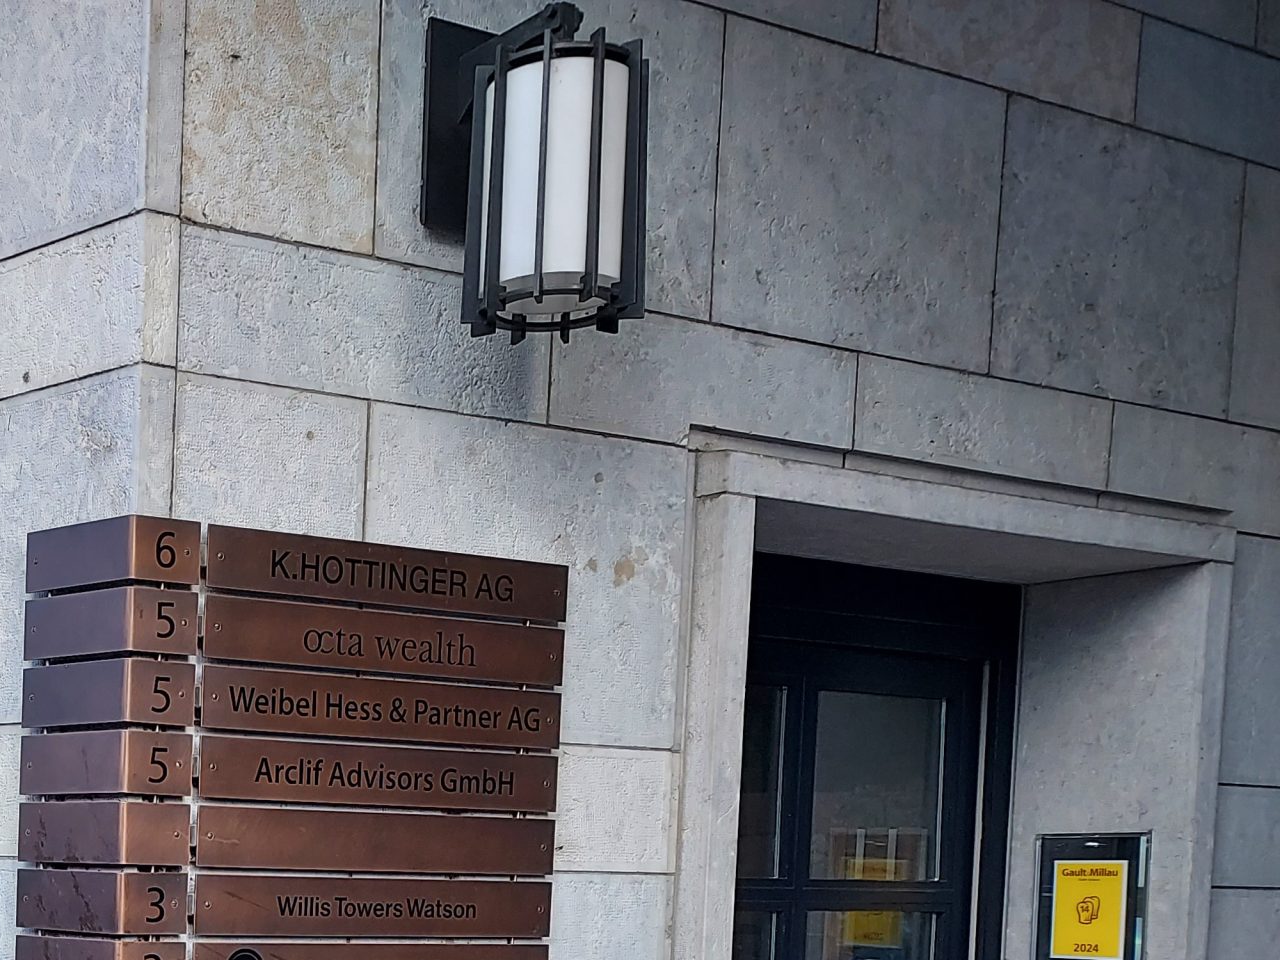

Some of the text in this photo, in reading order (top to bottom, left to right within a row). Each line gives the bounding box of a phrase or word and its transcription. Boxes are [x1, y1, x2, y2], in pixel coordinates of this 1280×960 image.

[154, 531, 177, 569] 6
[271, 550, 516, 603] K.HOTTINGER AG
[156, 602, 176, 639] 5
[303, 626, 477, 667] octa wealth
[151, 676, 171, 713] 5
[228, 684, 541, 733] Weibel Hess & Partner AG
[148, 747, 169, 784] 5
[254, 756, 516, 797] Arclif Advisors GmbH
[145, 886, 166, 924] 3
[277, 896, 477, 920] Willis Towers Watson
[1073, 943, 1099, 953] 2024
